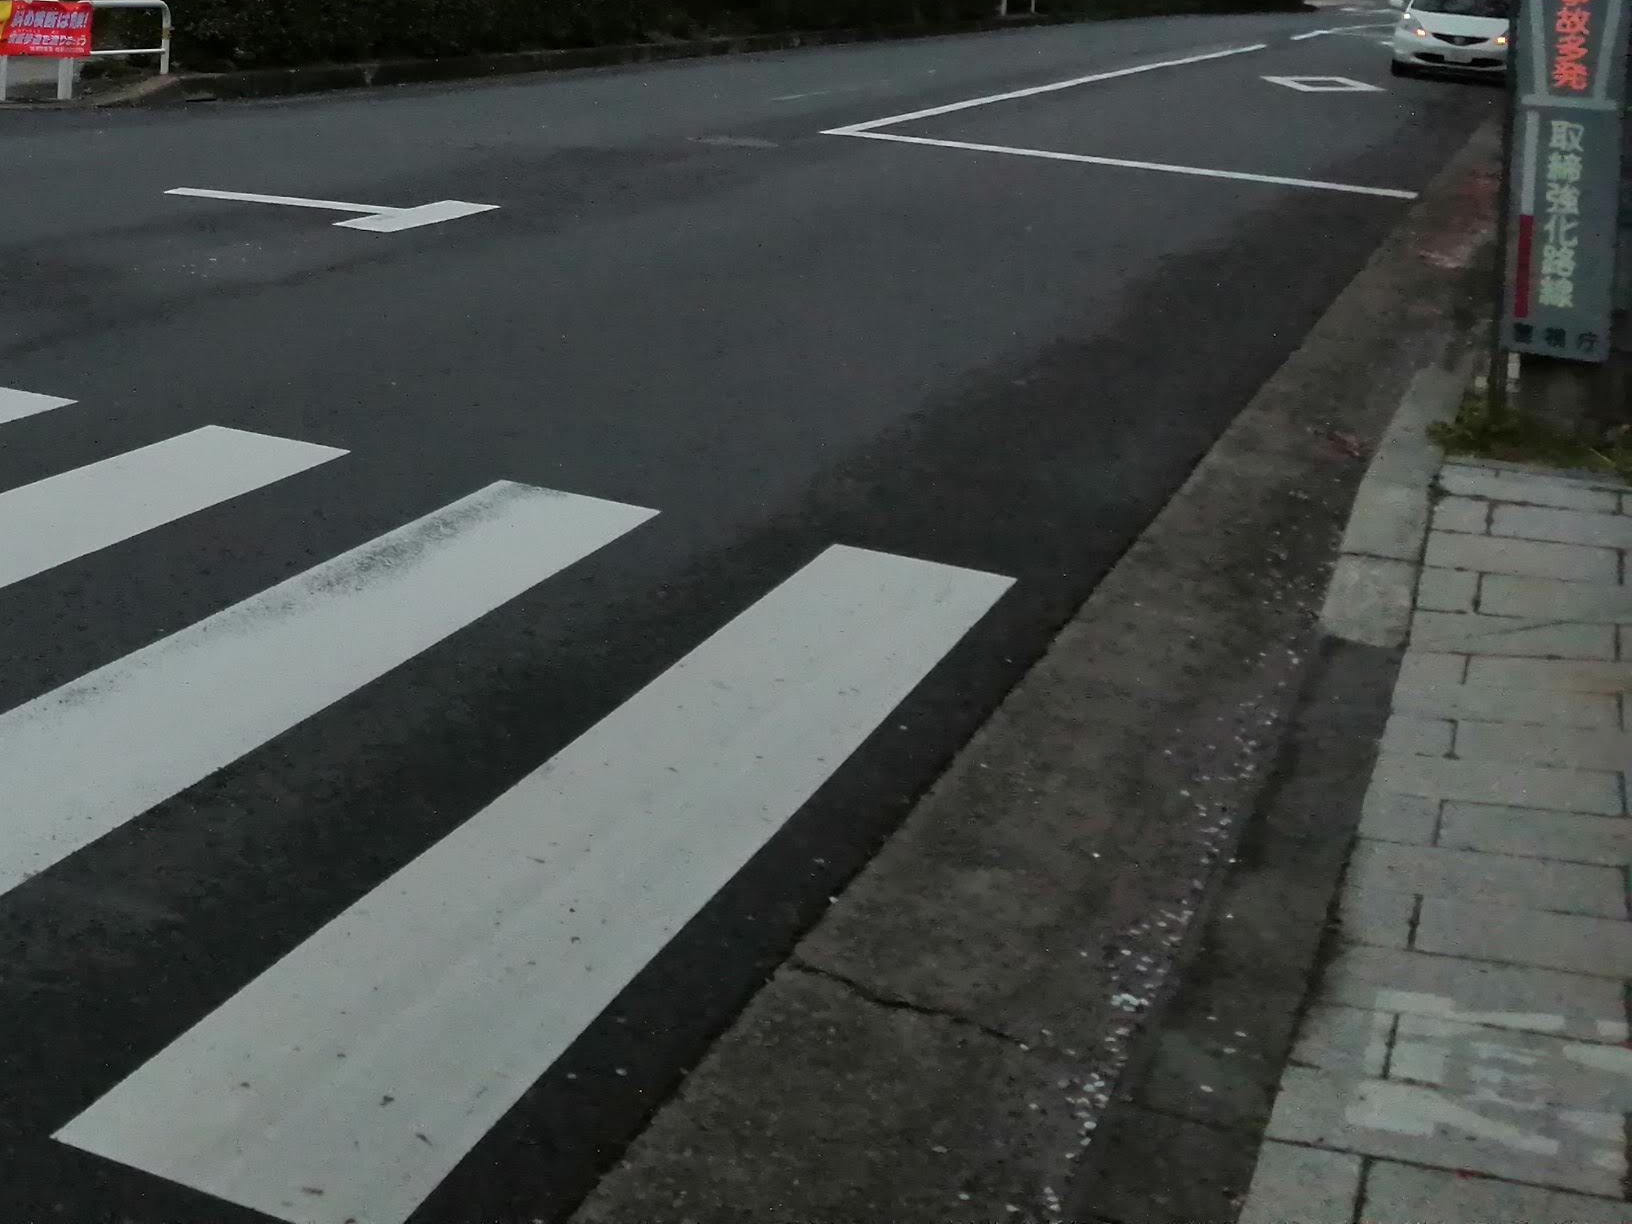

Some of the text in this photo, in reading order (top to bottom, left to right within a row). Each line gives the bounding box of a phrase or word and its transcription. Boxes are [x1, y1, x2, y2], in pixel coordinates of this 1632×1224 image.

[1538, 120, 1584, 308] 取締強化路線
